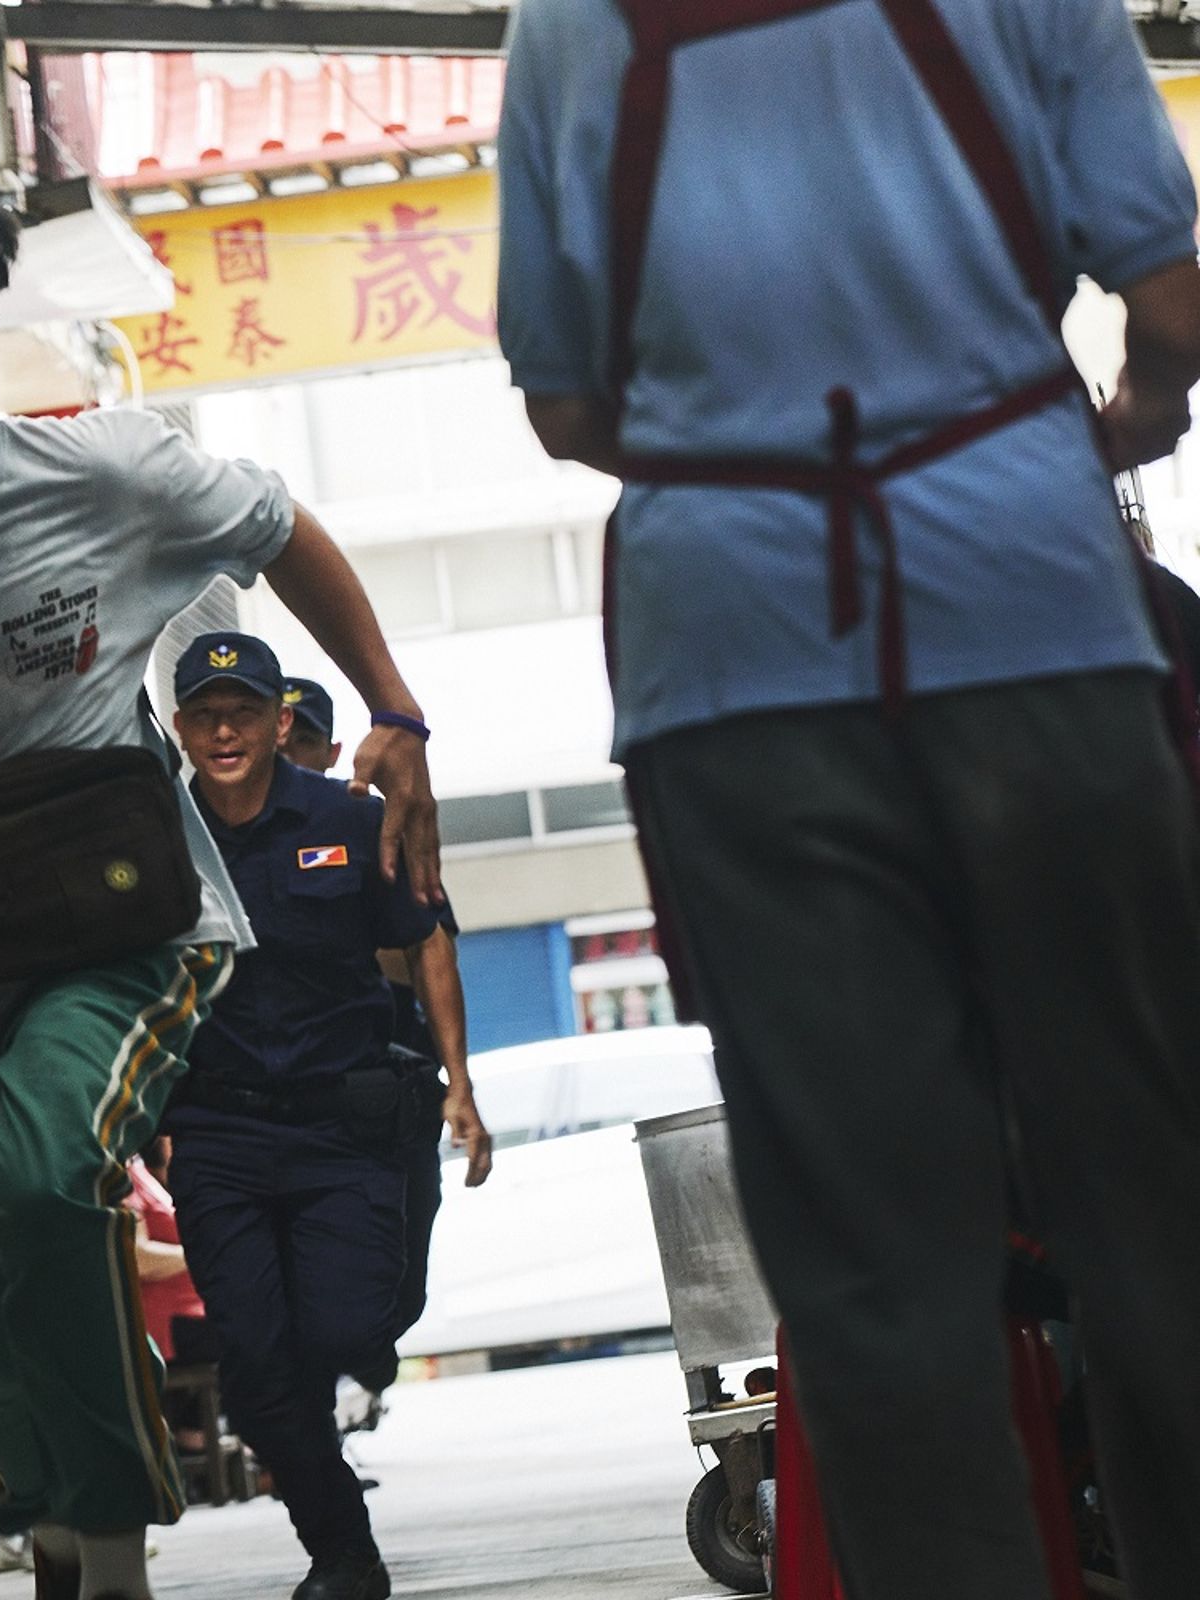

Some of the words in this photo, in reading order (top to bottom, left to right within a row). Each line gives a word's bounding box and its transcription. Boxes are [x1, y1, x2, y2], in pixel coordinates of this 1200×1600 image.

[351, 202, 497, 343] 歲
[1, 603, 57, 636] ROLLING
[59, 585, 98, 612] STONES
[39, 587, 61, 604] THE
[33, 611, 80, 636] PRESENTS
